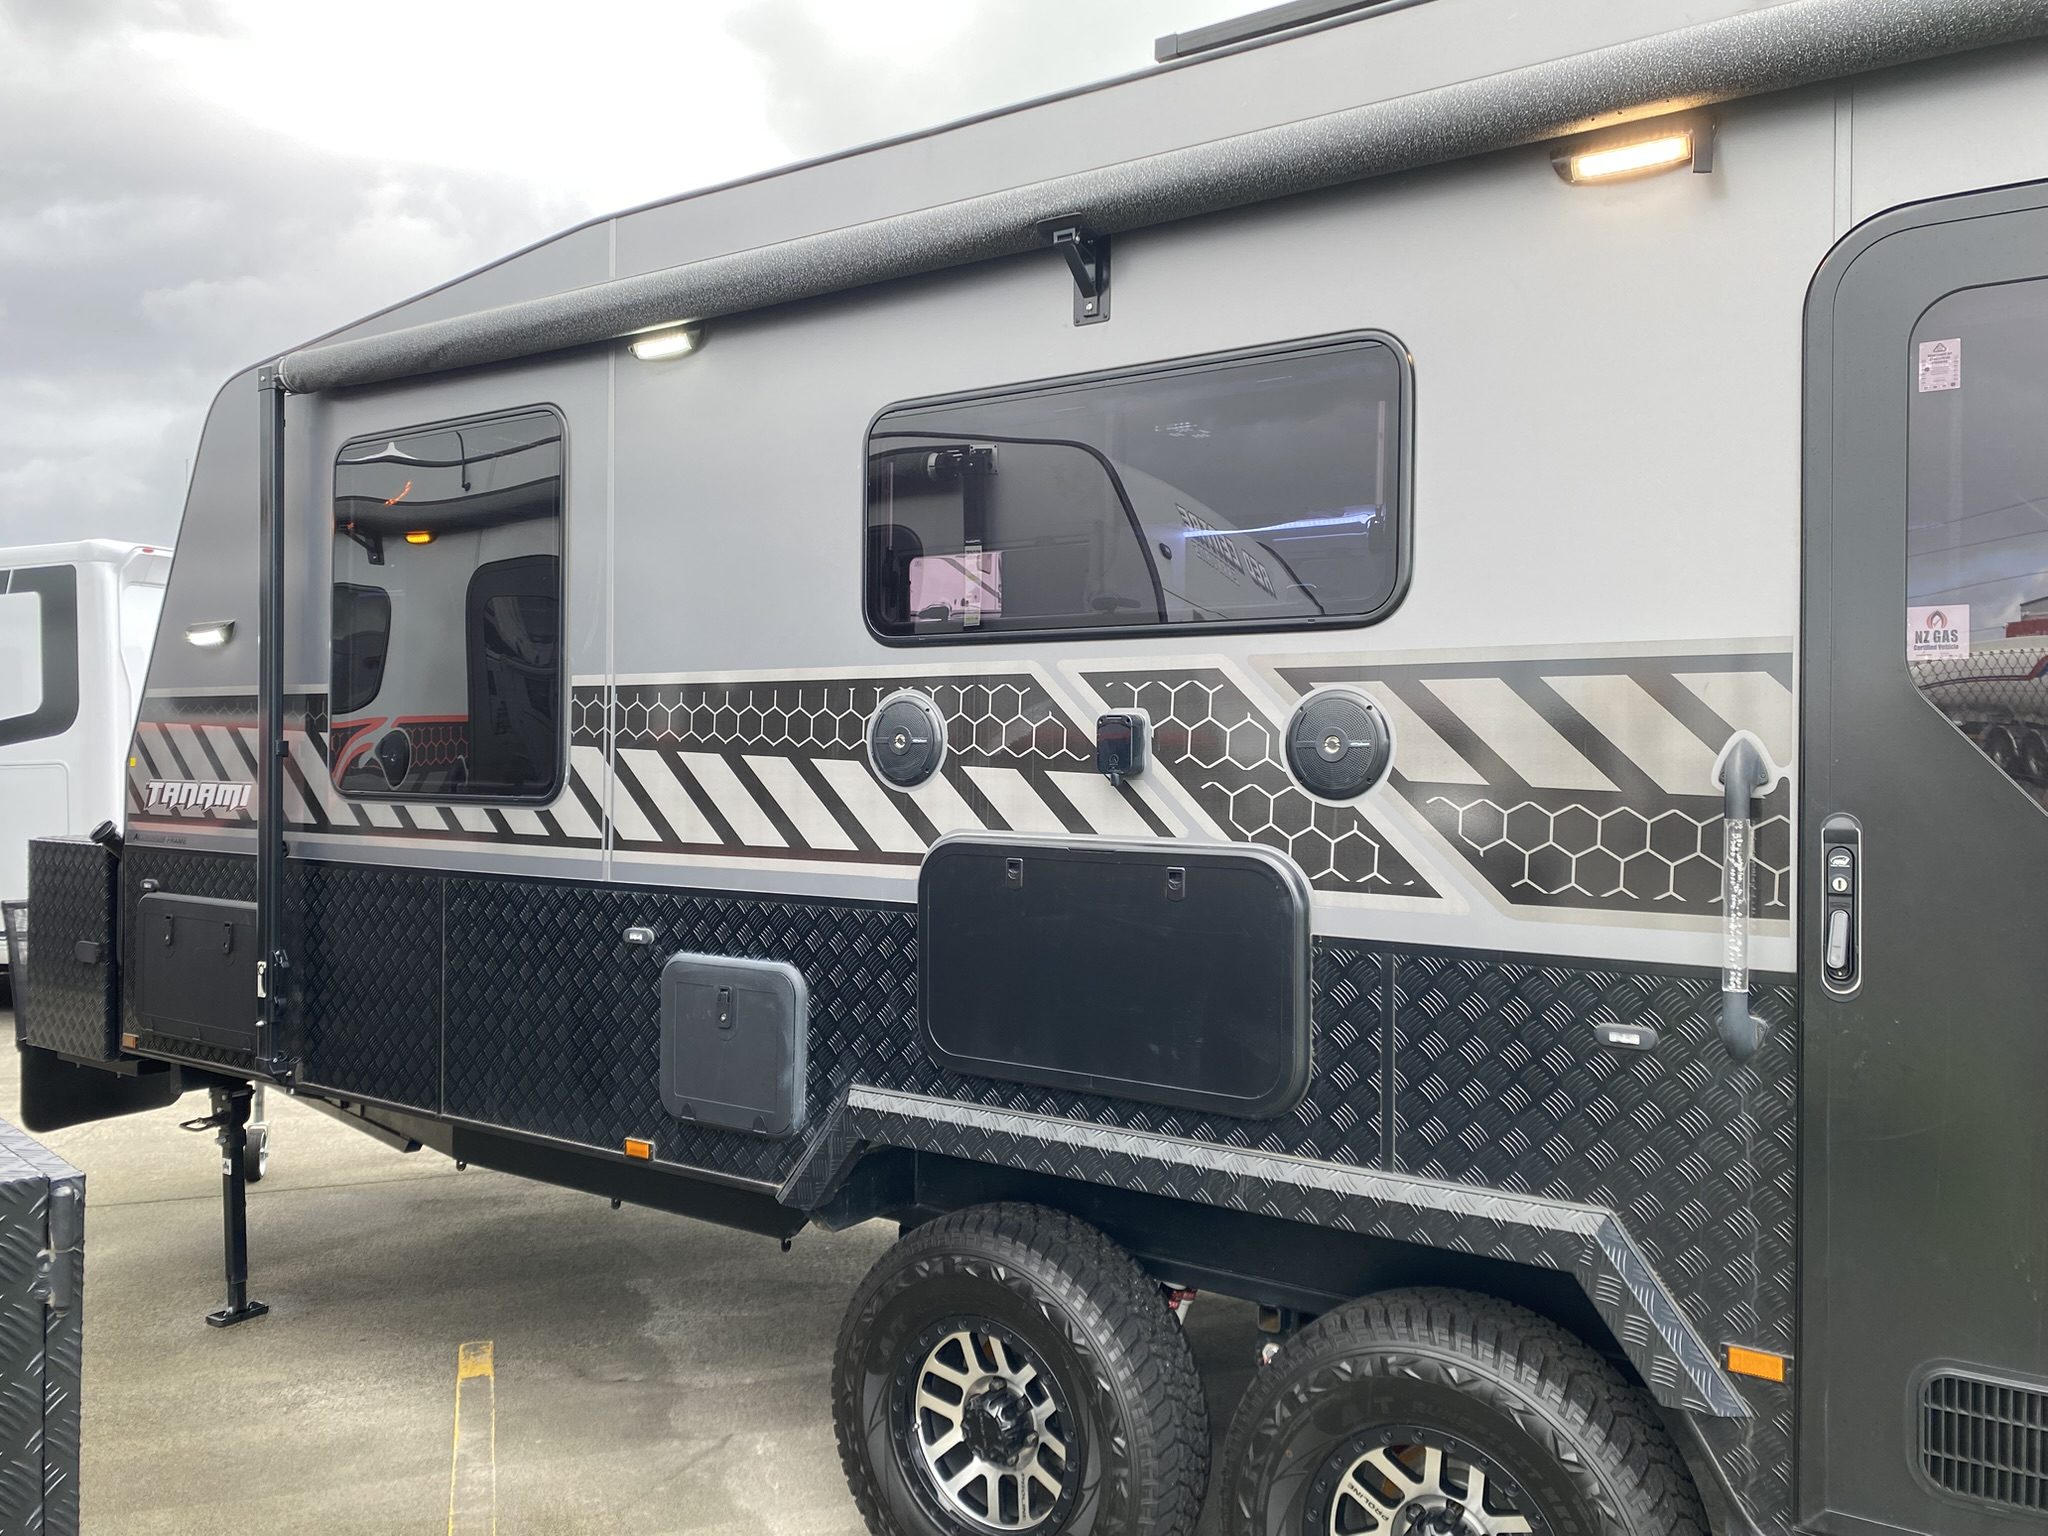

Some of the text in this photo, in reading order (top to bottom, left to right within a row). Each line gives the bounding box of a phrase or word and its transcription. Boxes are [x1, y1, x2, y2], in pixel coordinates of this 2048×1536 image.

[1915, 629, 1959, 644] NZ GAS
[146, 781, 252, 811] TANAMI
[1346, 1482, 1390, 1522] PROLINE
